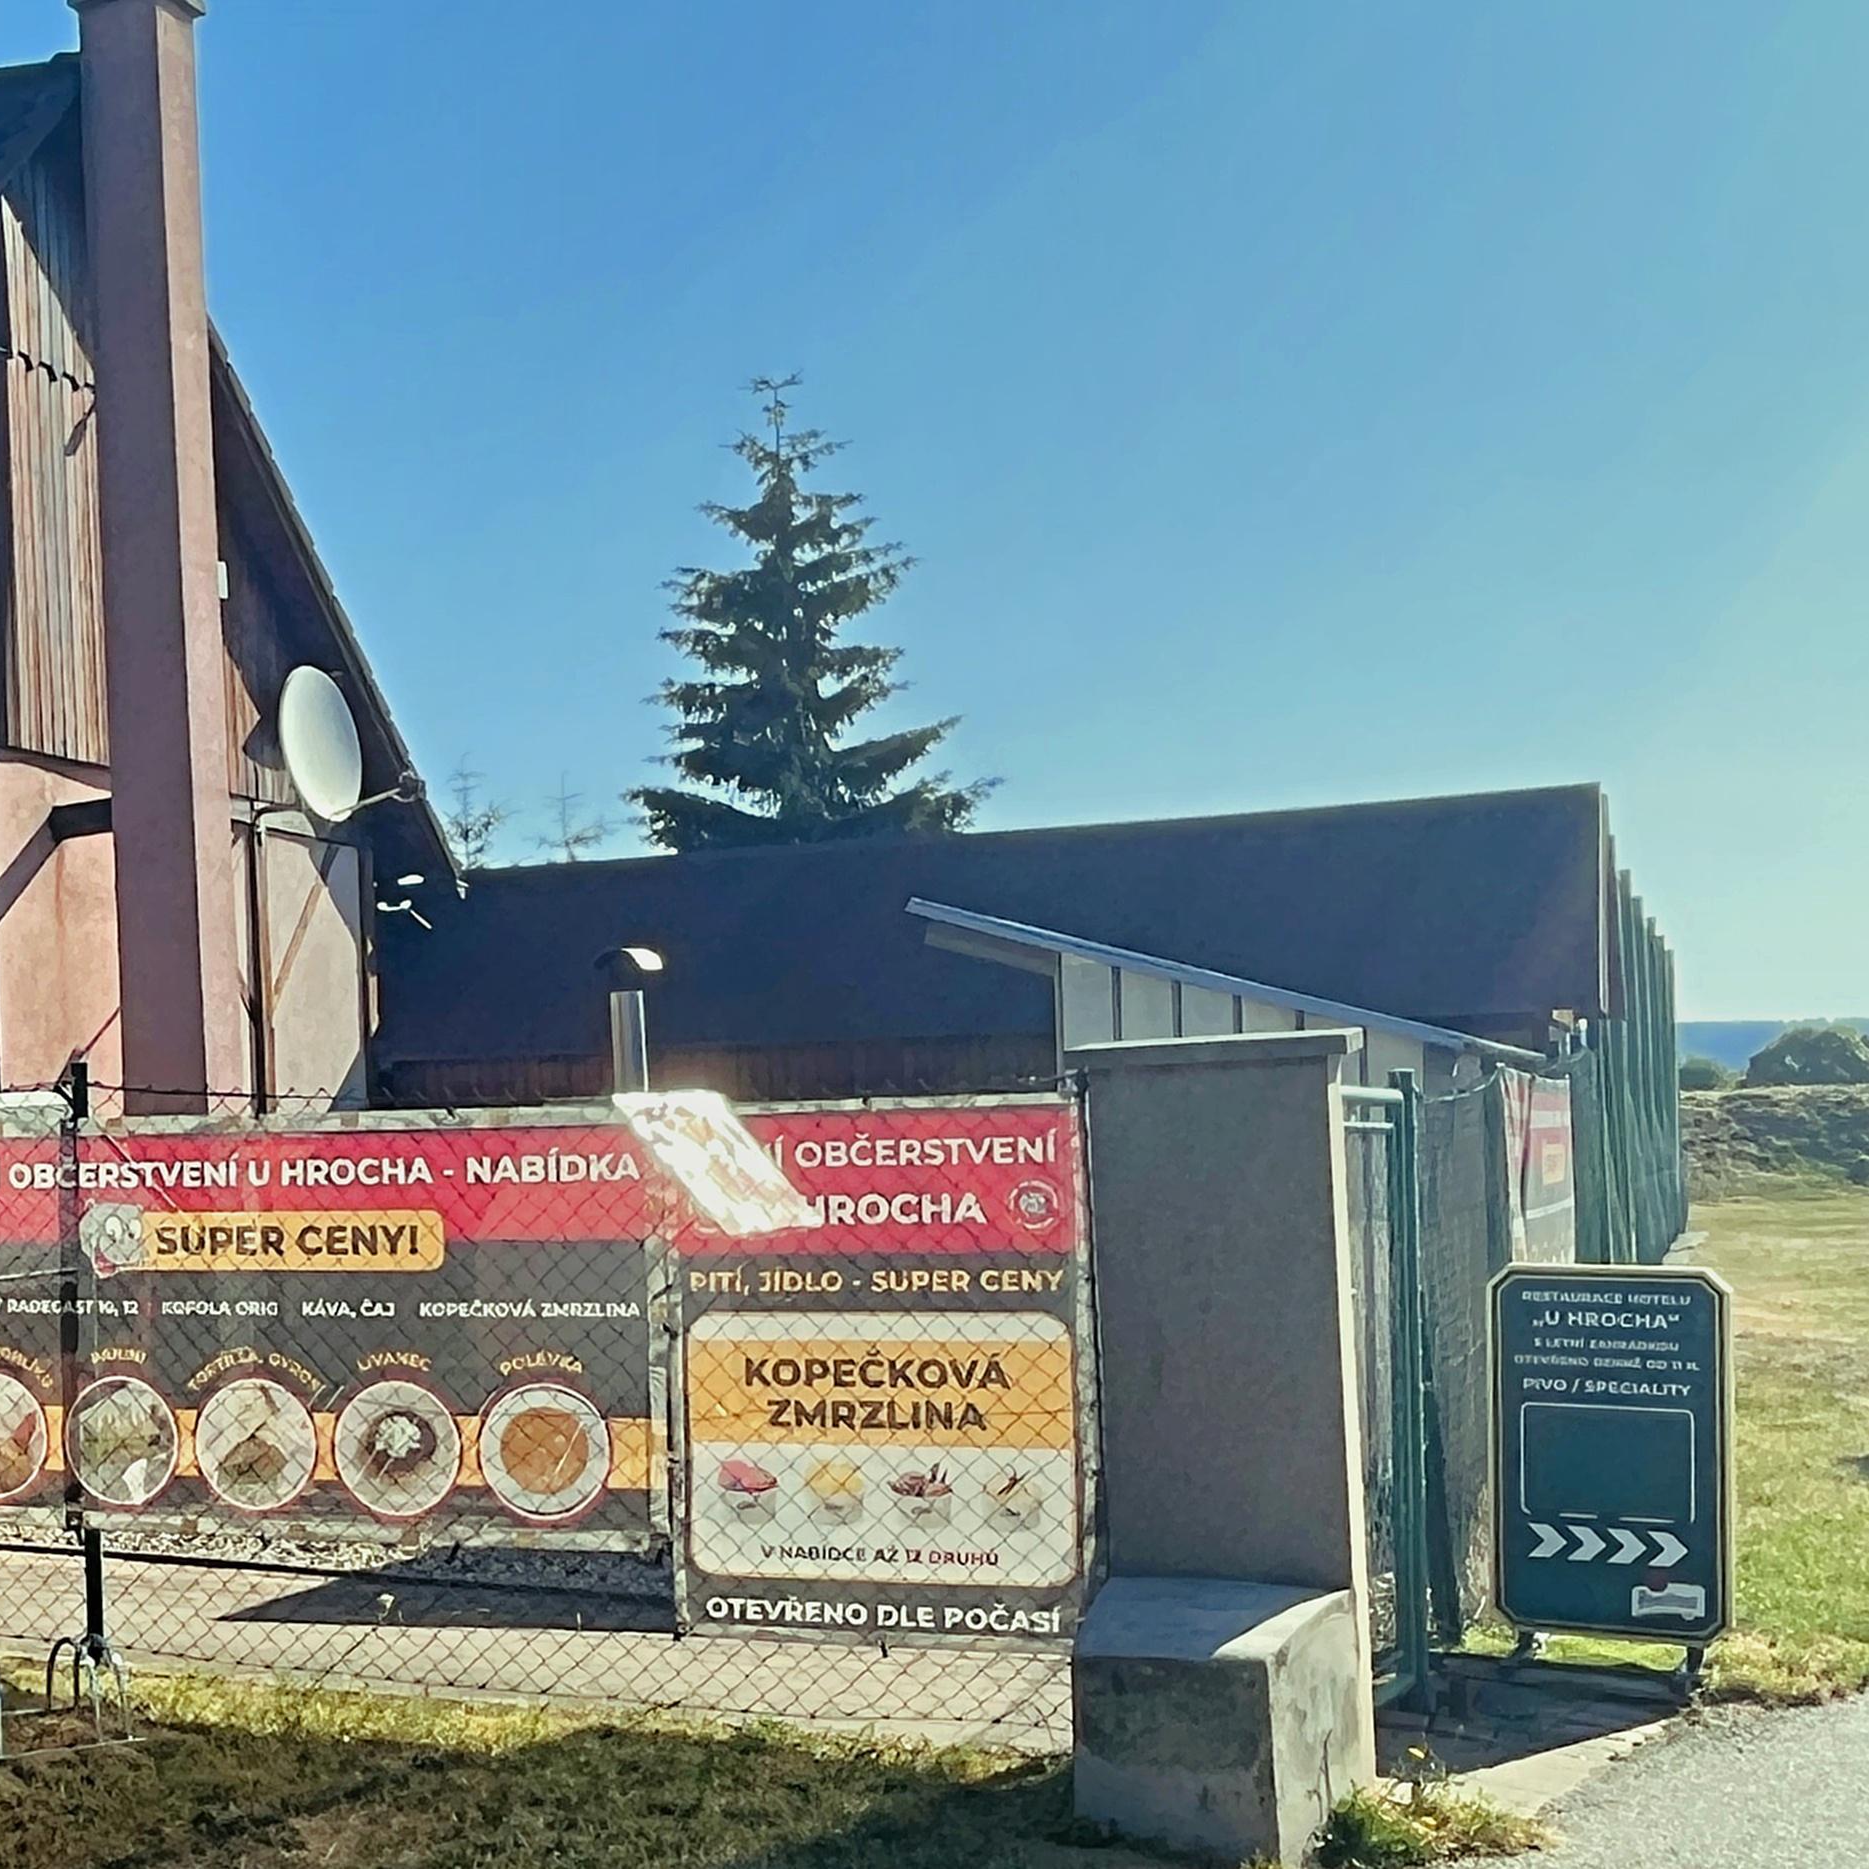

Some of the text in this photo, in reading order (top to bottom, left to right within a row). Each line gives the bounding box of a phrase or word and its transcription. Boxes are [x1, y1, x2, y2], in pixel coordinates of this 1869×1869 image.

[794, 1129, 1057, 1168] OBČERSTVENÍ
[8, 1153, 240, 1191] OBČERSTVENÍ
[247, 1161, 272, 1186] U
[280, 1156, 434, 1187] HROCHA
[465, 1147, 641, 1185] NABÍDKA
[155, 1223, 420, 1258] SUPER CENY!
[690, 1264, 750, 1296] PITÍ,
[759, 1264, 842, 1293] JÍDLO
[871, 1270, 969, 1292] SUPER
[979, 1269, 1064, 1292] CENY
[161, 1299, 231, 1316] KOFOLA
[361, 1298, 396, 1318] ČAJ
[419, 1298, 536, 1318] KOPEČKOVÁ
[540, 1301, 641, 1318] ZMRZLINA
[744, 1348, 1011, 1390] KOPEČKOVÁ
[1522, 1377, 1568, 1391] PIVO
[1584, 1379, 1693, 1396] SPECIALITY
[767, 1400, 987, 1431] ZMRZLINA
[779, 1544, 867, 1563] NABÍDCE
[873, 1545, 899, 1564] AŽ
[706, 1596, 1061, 1633] OTEVŘENO DLE POČASÍ
